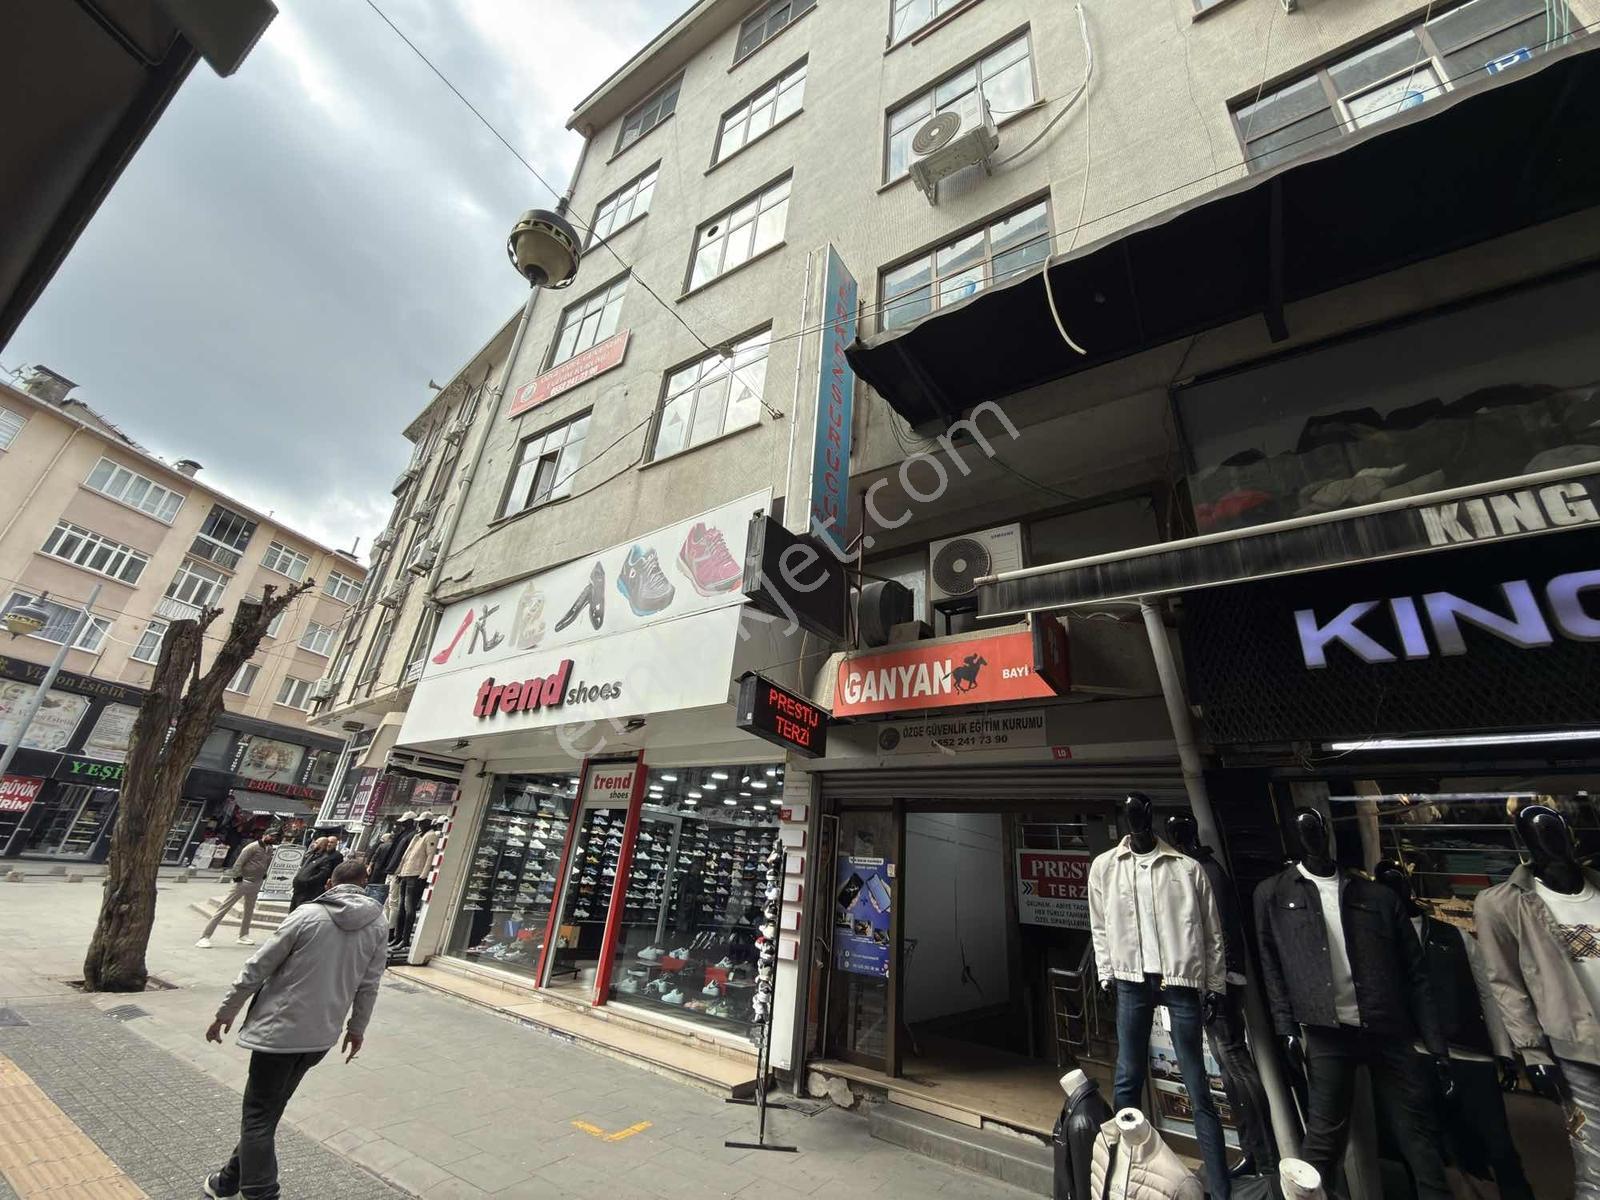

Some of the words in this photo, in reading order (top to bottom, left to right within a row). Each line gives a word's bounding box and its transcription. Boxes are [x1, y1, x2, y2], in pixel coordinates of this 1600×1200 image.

[1420, 482, 1600, 546] KING
[24, 664, 74, 687] Vizon
[844, 659, 952, 705] GANYAN
[1002, 664, 1028, 680] BAYİ
[473, 659, 575, 718] trend
[566, 680, 622, 706] shoes
[769, 688, 819, 727] PRESTİJ
[775, 714, 810, 747] TERZİ
[902, 725, 924, 739] ÖZGE
[926, 721, 967, 737] GÜVENLİK
[969, 716, 1000, 734] EĞİTİM
[1002, 715, 1043, 732] KURUMU
[958, 735, 976, 746] 241
[979, 735, 992, 745] 73
[995, 734, 1008, 745] 90
[0, 779, 38, 797] BÜYÜK
[593, 772, 633, 790] trend
[609, 791, 629, 799] shoes
